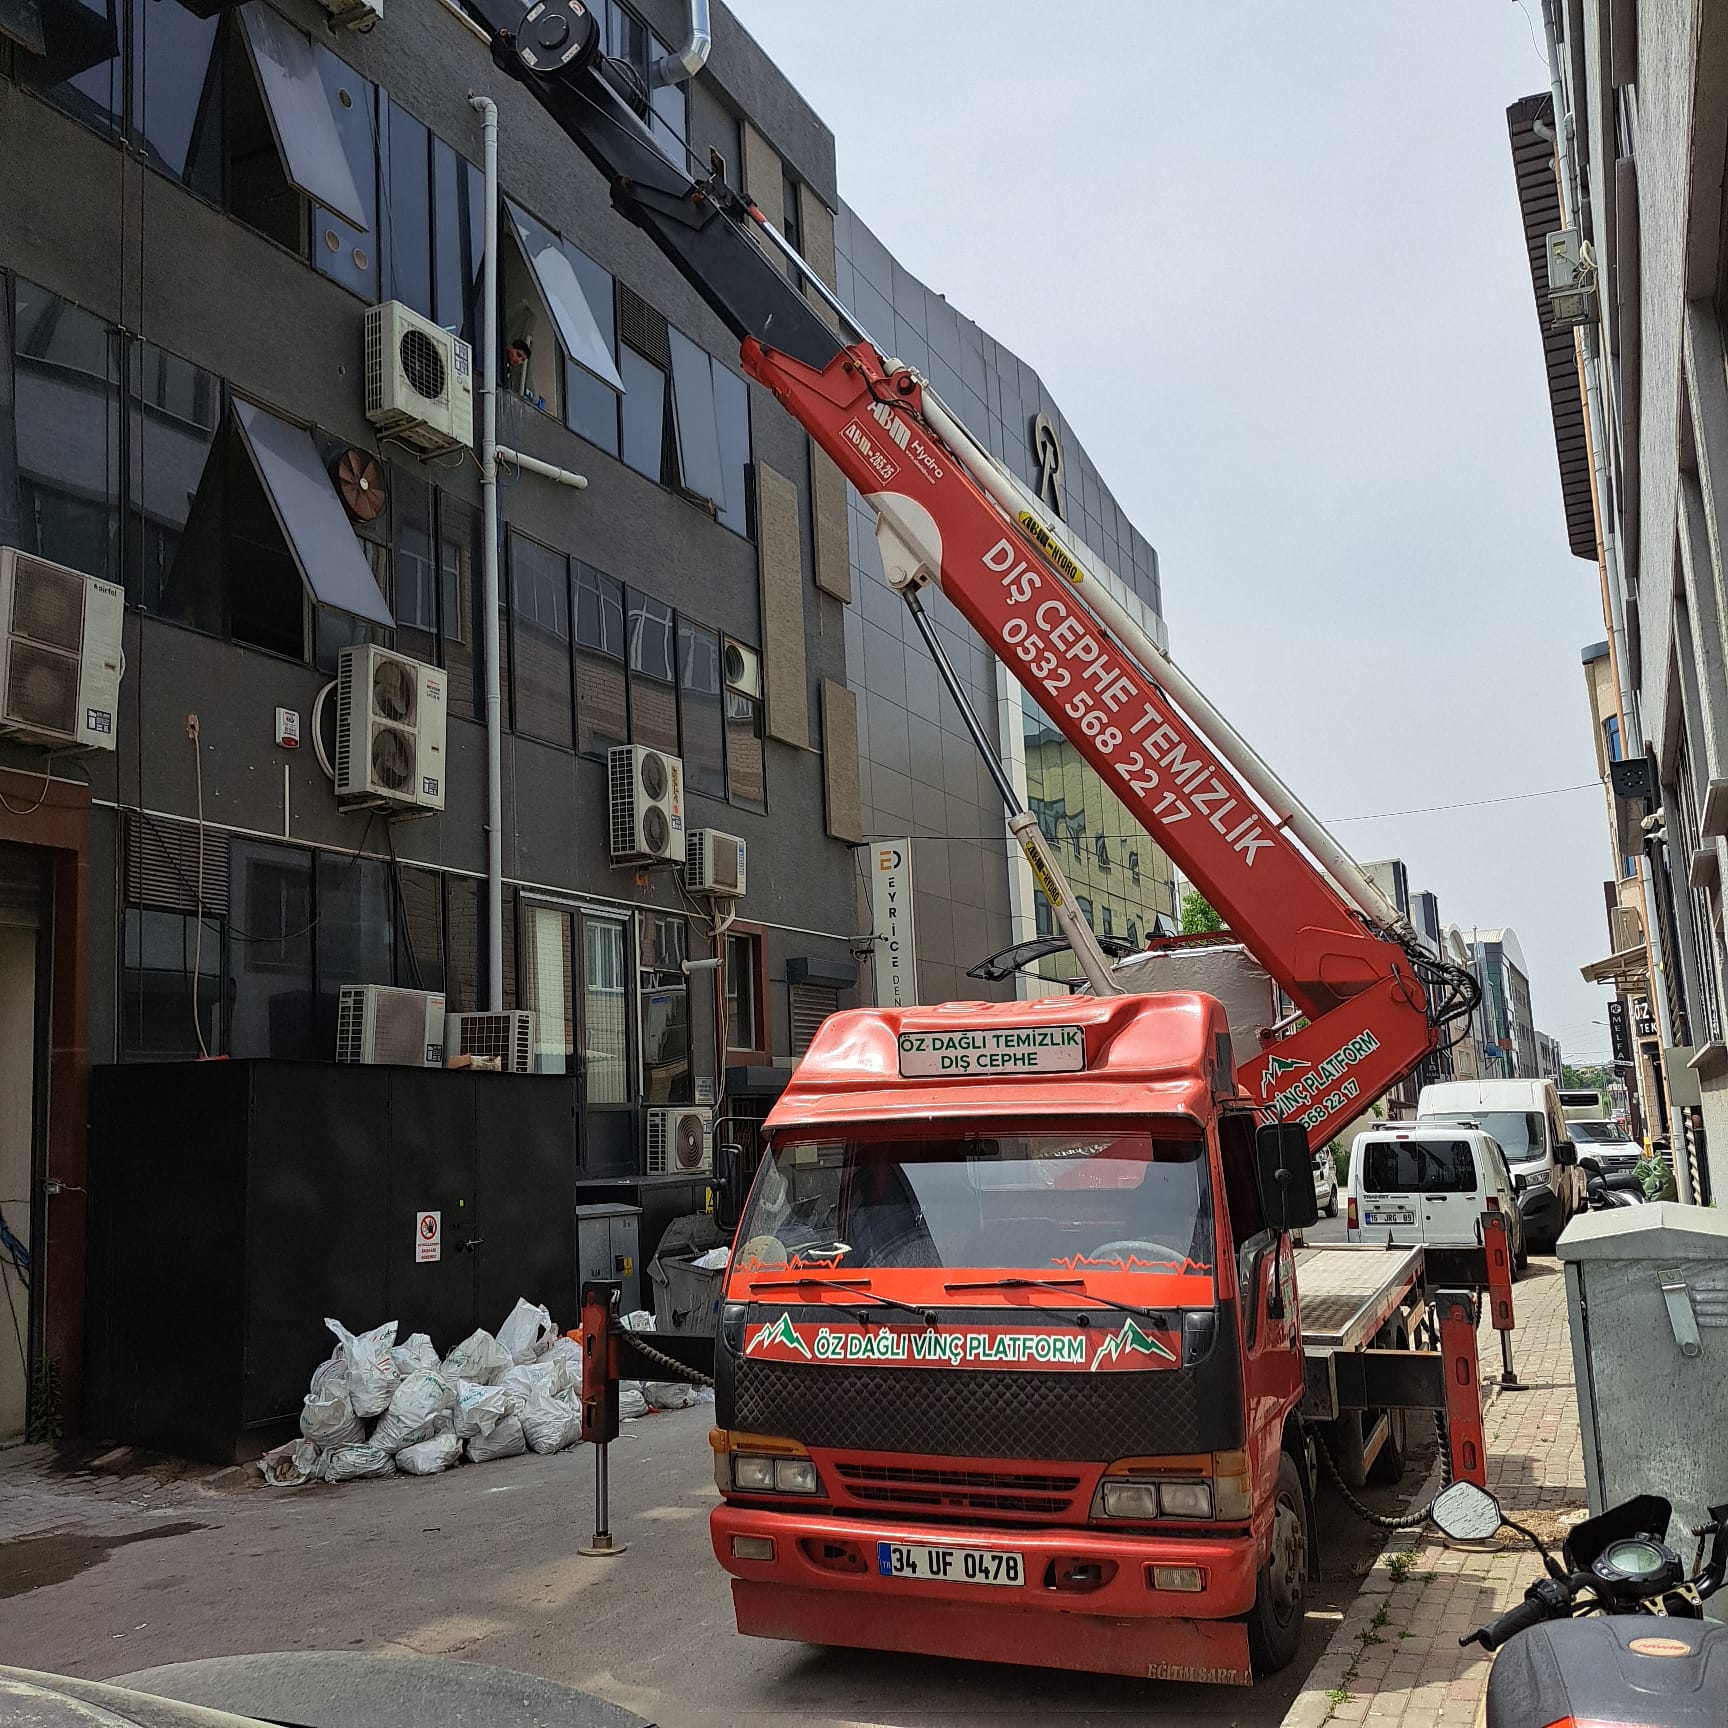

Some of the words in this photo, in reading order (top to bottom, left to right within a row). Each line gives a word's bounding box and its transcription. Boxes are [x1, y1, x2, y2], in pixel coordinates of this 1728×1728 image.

[911, 440, 944, 479] Hydro
[982, 538, 1042, 605] DIŞ
[1035, 600, 1139, 713] CEPHE
[1129, 702, 1275, 868] TEMİZLİK
[1002, 618, 1072, 697] 0532
[1065, 692, 1123, 754] 568
[1114, 751, 1160, 798] 22
[1152, 791, 1192, 825] 17
[900, 1035, 926, 1052] ÖZ
[932, 1033, 987, 1050] DAĞLI
[992, 1028, 1080, 1048] TEMİZLİK
[1612, 1016, 1625, 1059] MELFA
[941, 1055, 971, 1072] DIŞ
[976, 1051, 1039, 1068] CEPHE
[1301, 1029, 1381, 1095] PLATFORM
[1323, 1090, 1348, 1114] 22
[1341, 1076, 1360, 1098] 17
[813, 1328, 844, 1359] ÖZ
[847, 1326, 908, 1360] DAĞLI
[911, 1329, 964, 1367] VİNÇ
[966, 1334, 1086, 1363] PLATFORM
[892, 1547, 917, 1574] 34
[928, 1550, 954, 1577] UF
[963, 1553, 1019, 1581] 0478
